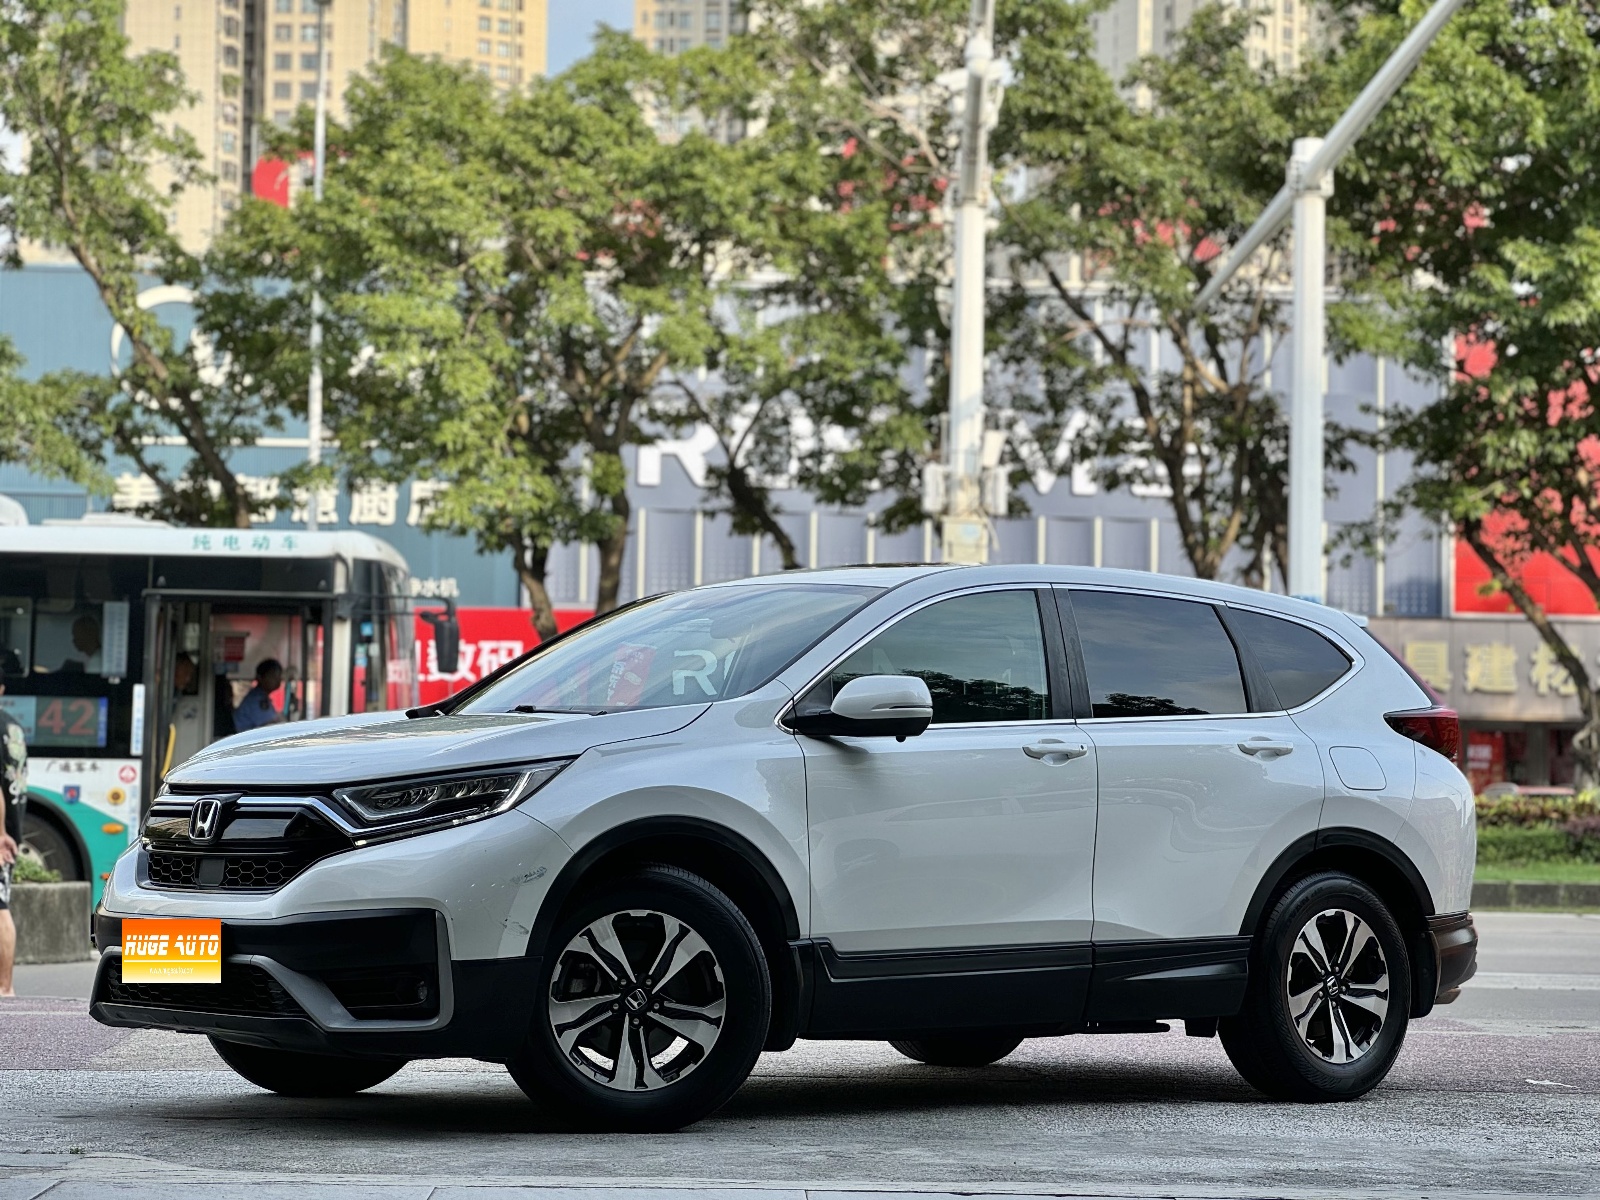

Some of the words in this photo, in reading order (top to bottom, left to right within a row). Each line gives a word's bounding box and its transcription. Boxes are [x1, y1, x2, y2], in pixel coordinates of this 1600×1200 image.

[192, 534, 299, 551] 纯电动车
[38, 699, 96, 736] 42
